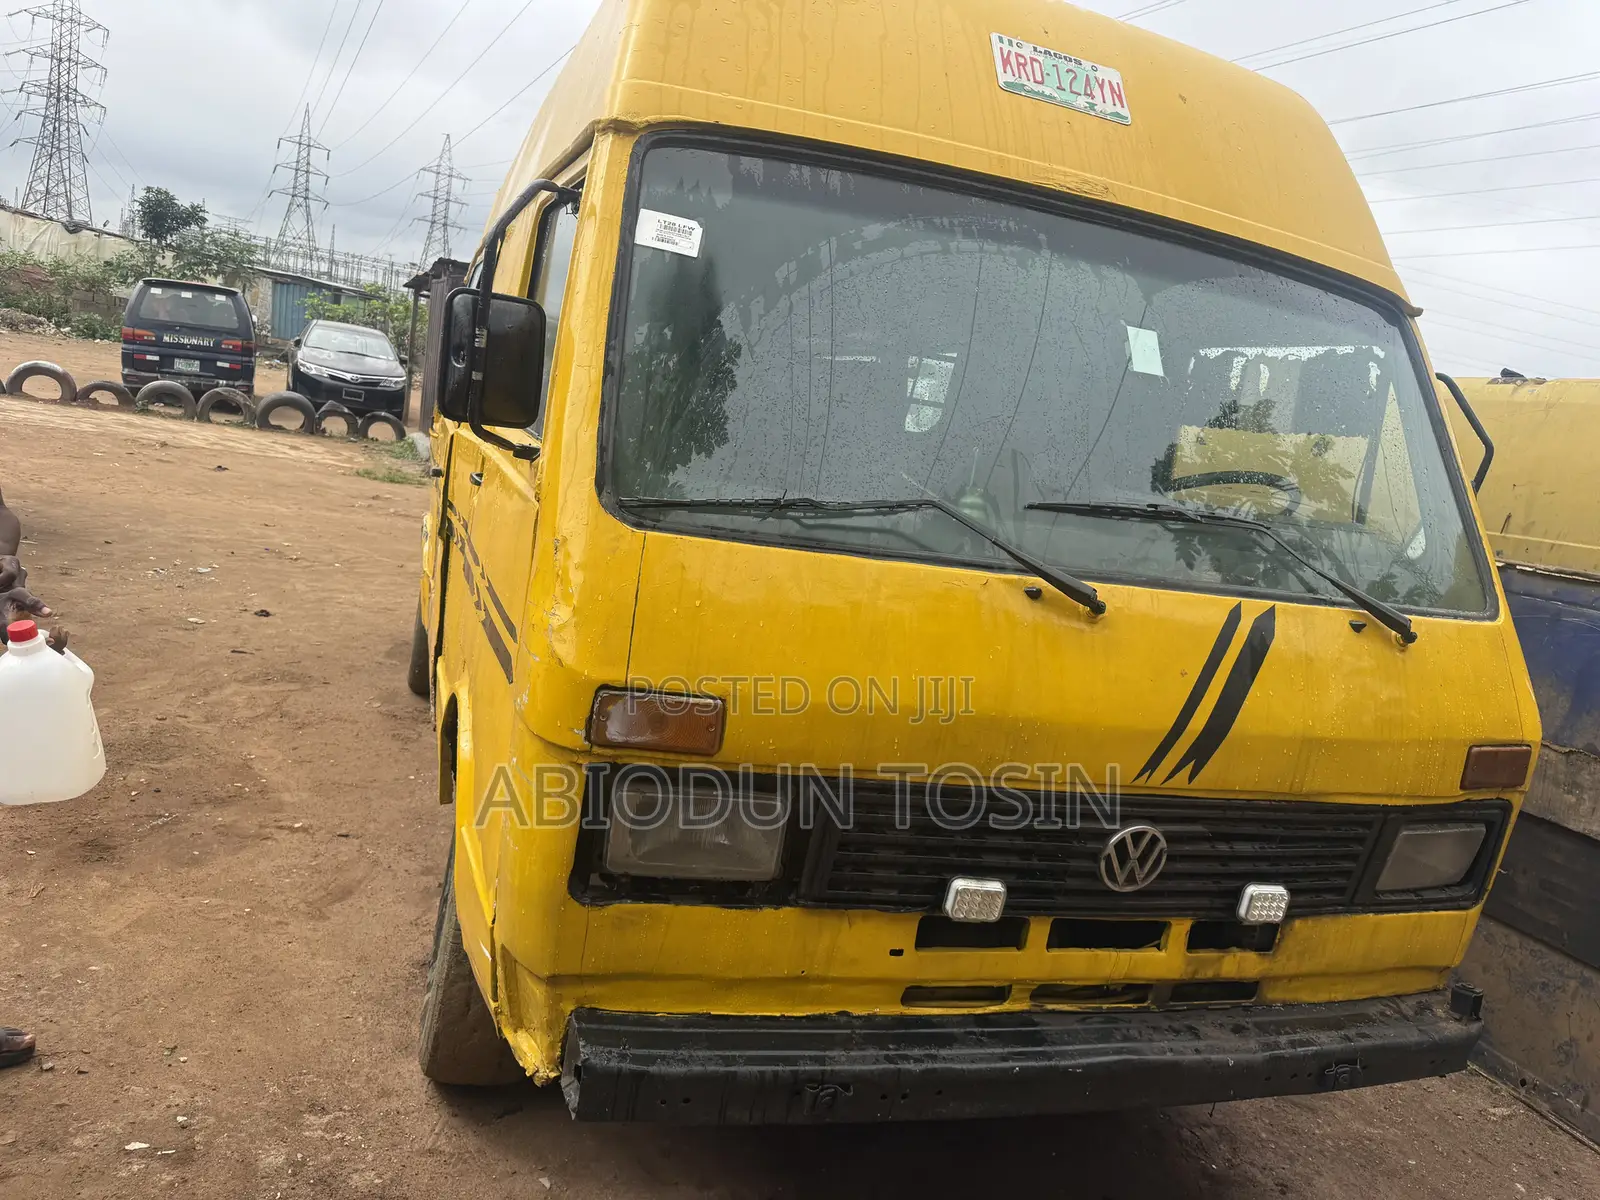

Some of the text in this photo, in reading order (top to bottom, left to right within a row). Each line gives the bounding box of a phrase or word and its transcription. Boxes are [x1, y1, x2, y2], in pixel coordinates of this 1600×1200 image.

[1032, 45, 1083, 66] LAGOS
[999, 46, 1125, 109] KRD-124YN
[162, 333, 216, 347] MISSIONARY
